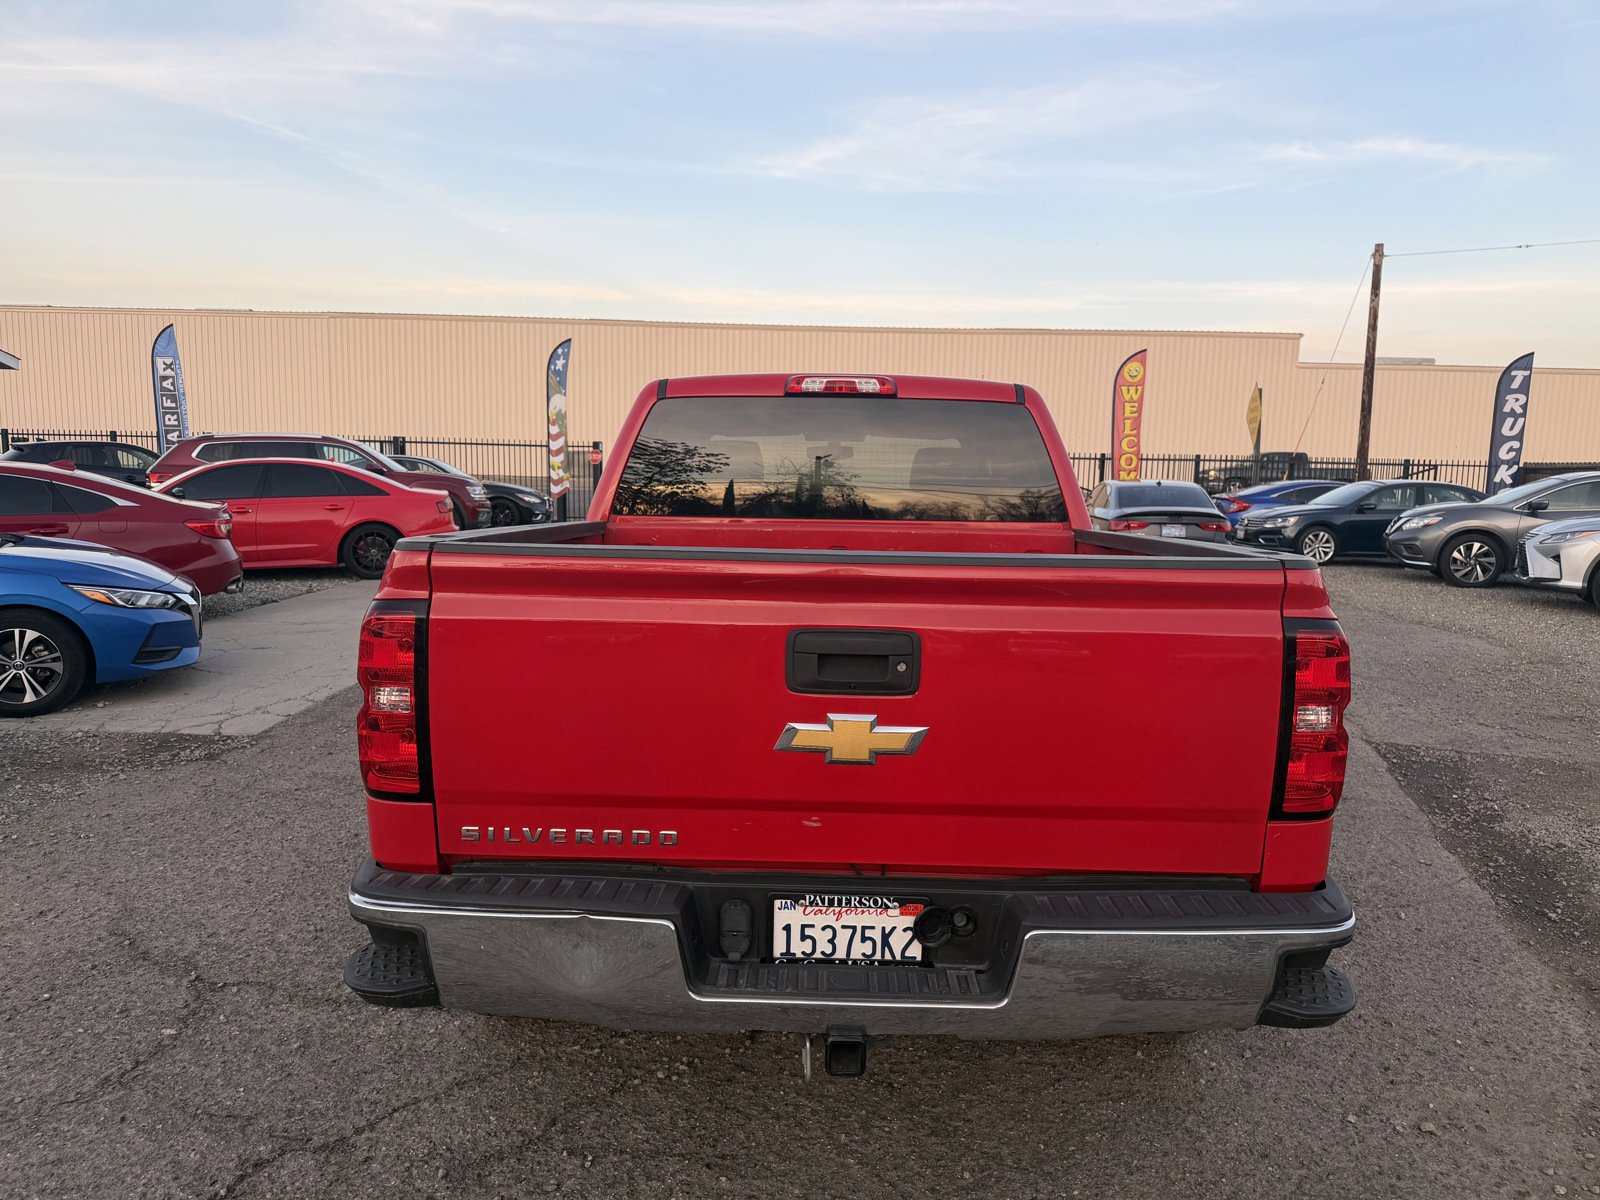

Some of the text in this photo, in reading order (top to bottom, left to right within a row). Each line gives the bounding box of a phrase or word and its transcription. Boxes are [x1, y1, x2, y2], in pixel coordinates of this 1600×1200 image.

[162, 360, 180, 442] ARFAX
[1119, 385, 1143, 481] WELCOM
[461, 826, 678, 846] SILVERADO
[777, 900, 797, 911] JAN
[804, 895, 894, 909] PATTERSON
[780, 923, 918, 961] 15375K2
